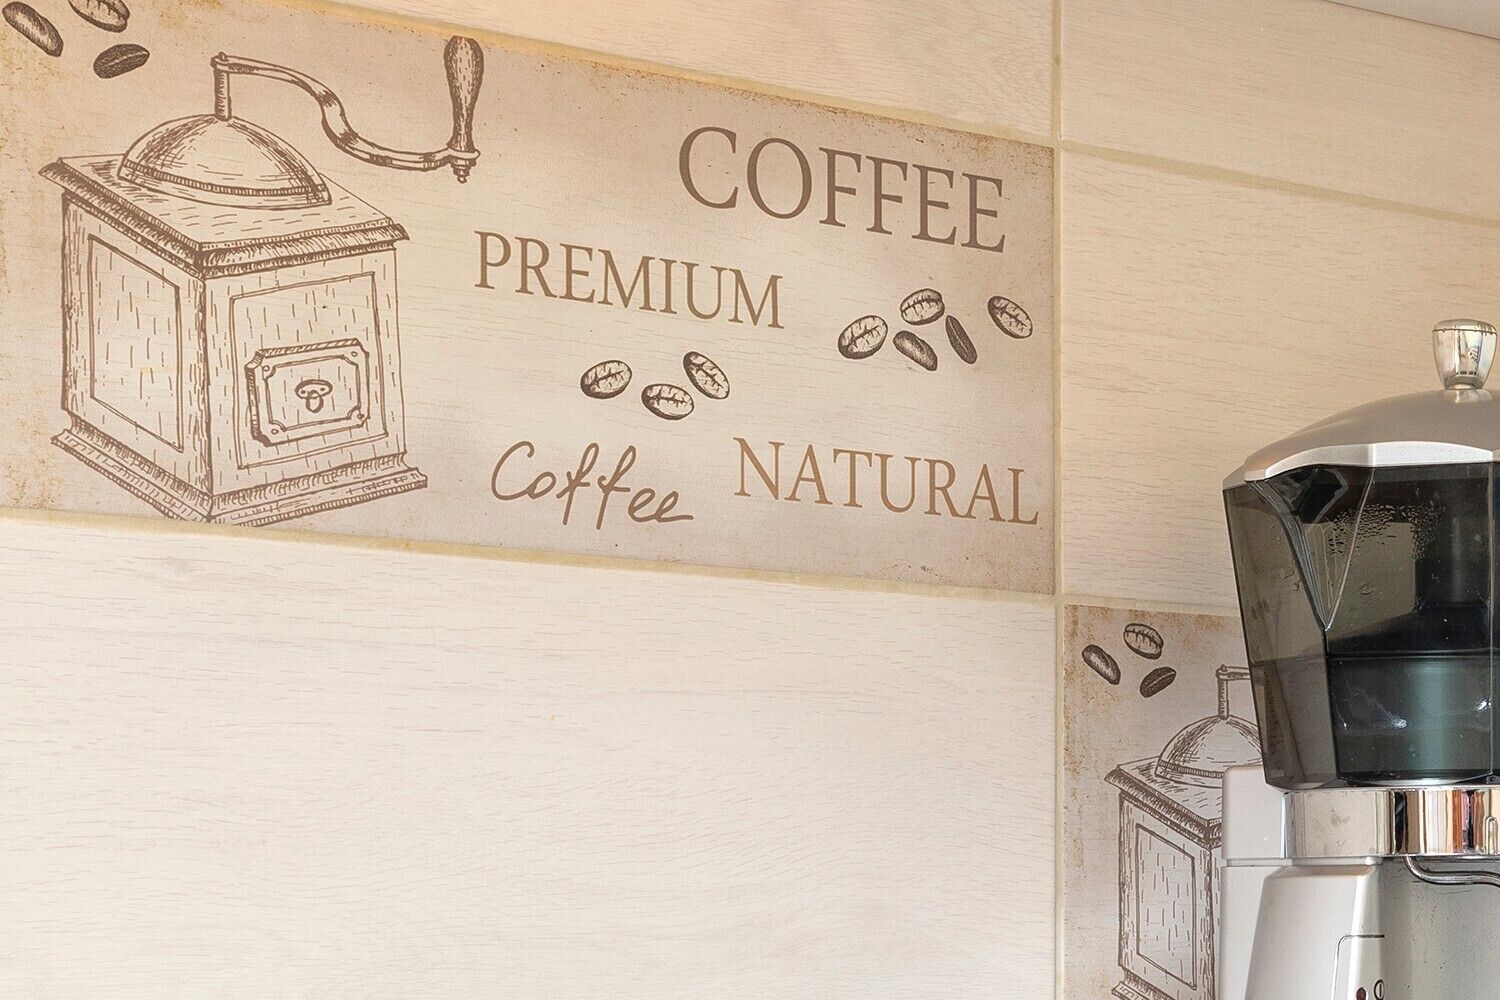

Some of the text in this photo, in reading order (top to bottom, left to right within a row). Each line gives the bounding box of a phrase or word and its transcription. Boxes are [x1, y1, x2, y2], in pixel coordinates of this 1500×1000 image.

[679, 127, 1006, 253] COFFEE
[474, 231, 785, 329] PREMIUM
[491, 441, 694, 530] Coffee
[733, 437, 1039, 526] NATURAL
